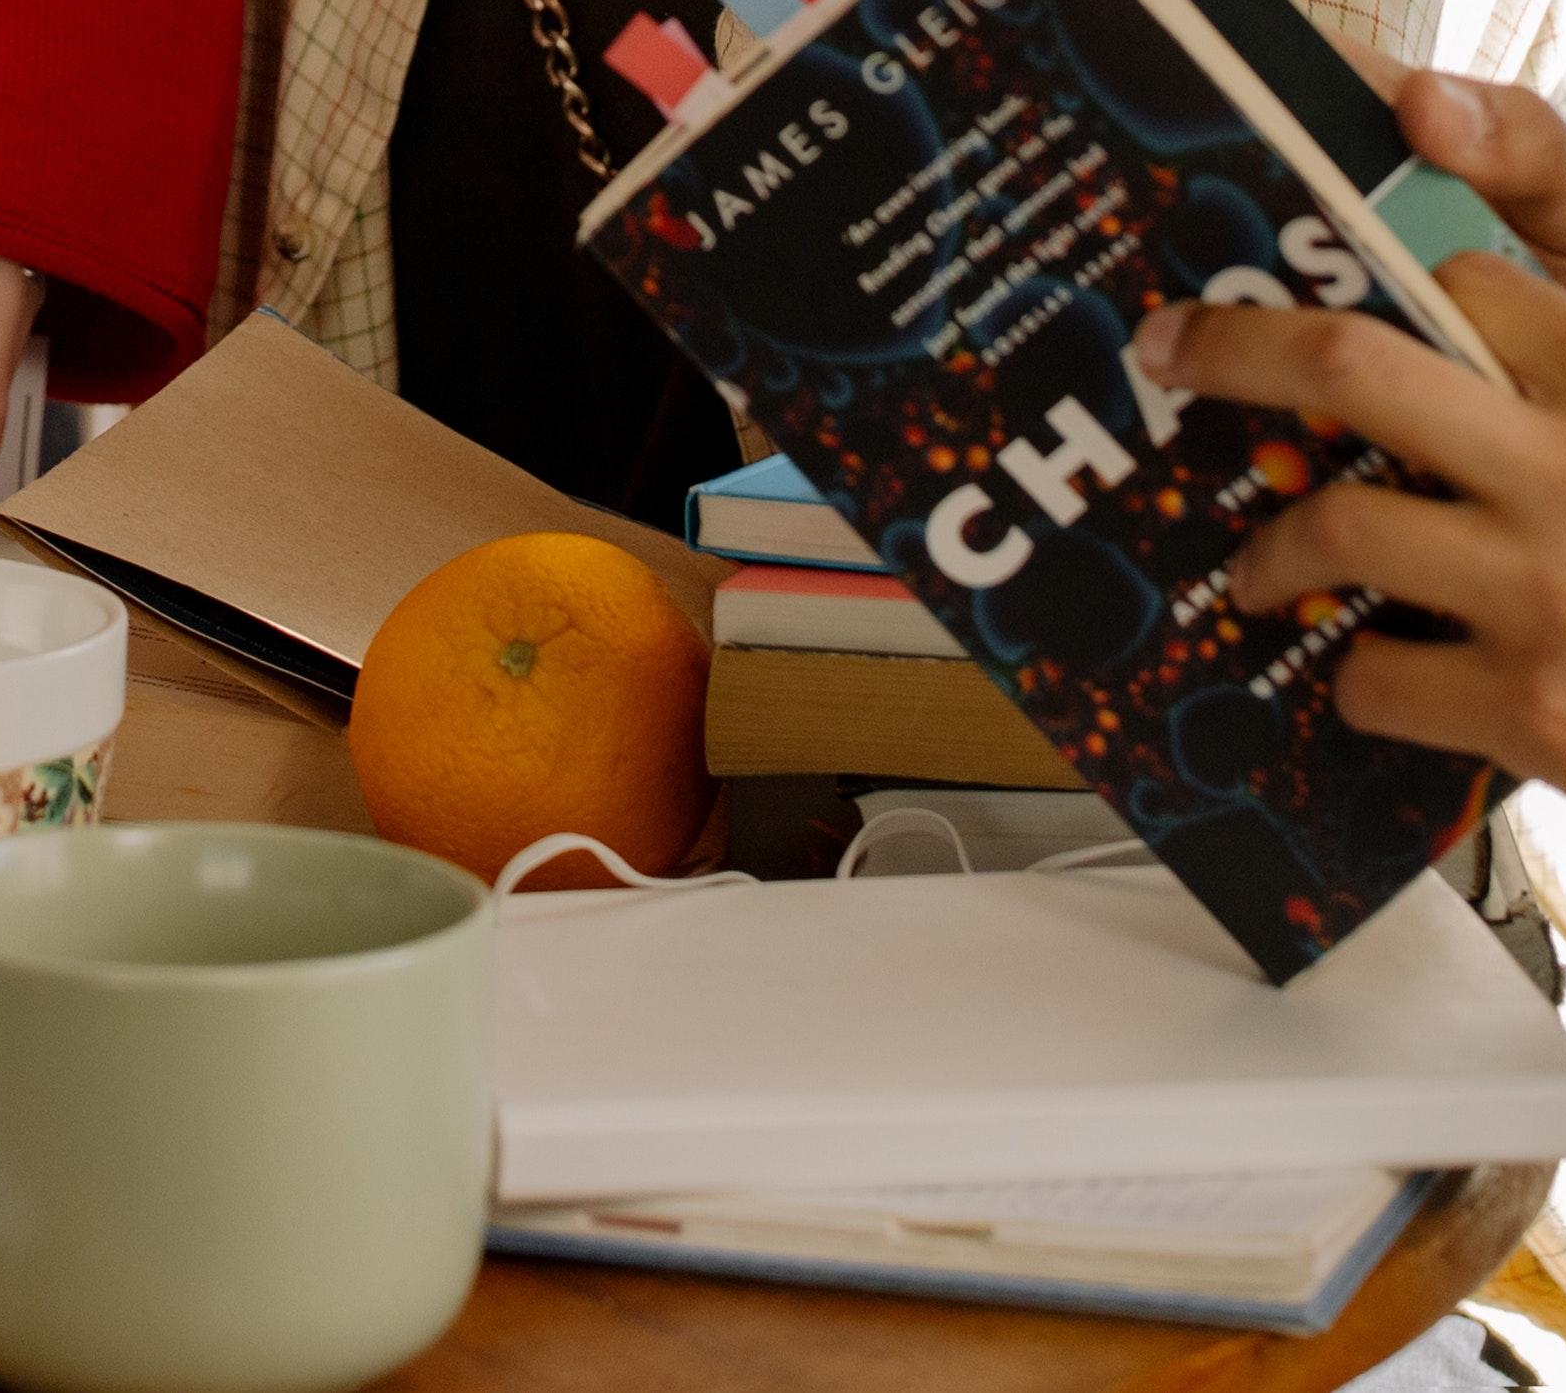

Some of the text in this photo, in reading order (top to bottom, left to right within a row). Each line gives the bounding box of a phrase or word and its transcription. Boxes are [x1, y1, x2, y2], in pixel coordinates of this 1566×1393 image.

[688, 100, 849, 251] JAMES
[858, 115, 1076, 294] Reading Chaos gave me the
[891, 142, 1108, 326] sensation that someone had
[923, 320, 962, 361] just
[955, 276, 1013, 327] found
[1006, 258, 1040, 285] the
[1032, 223, 1079, 264] light
[981, 233, 1141, 366] DOUGLAS ADAMS
